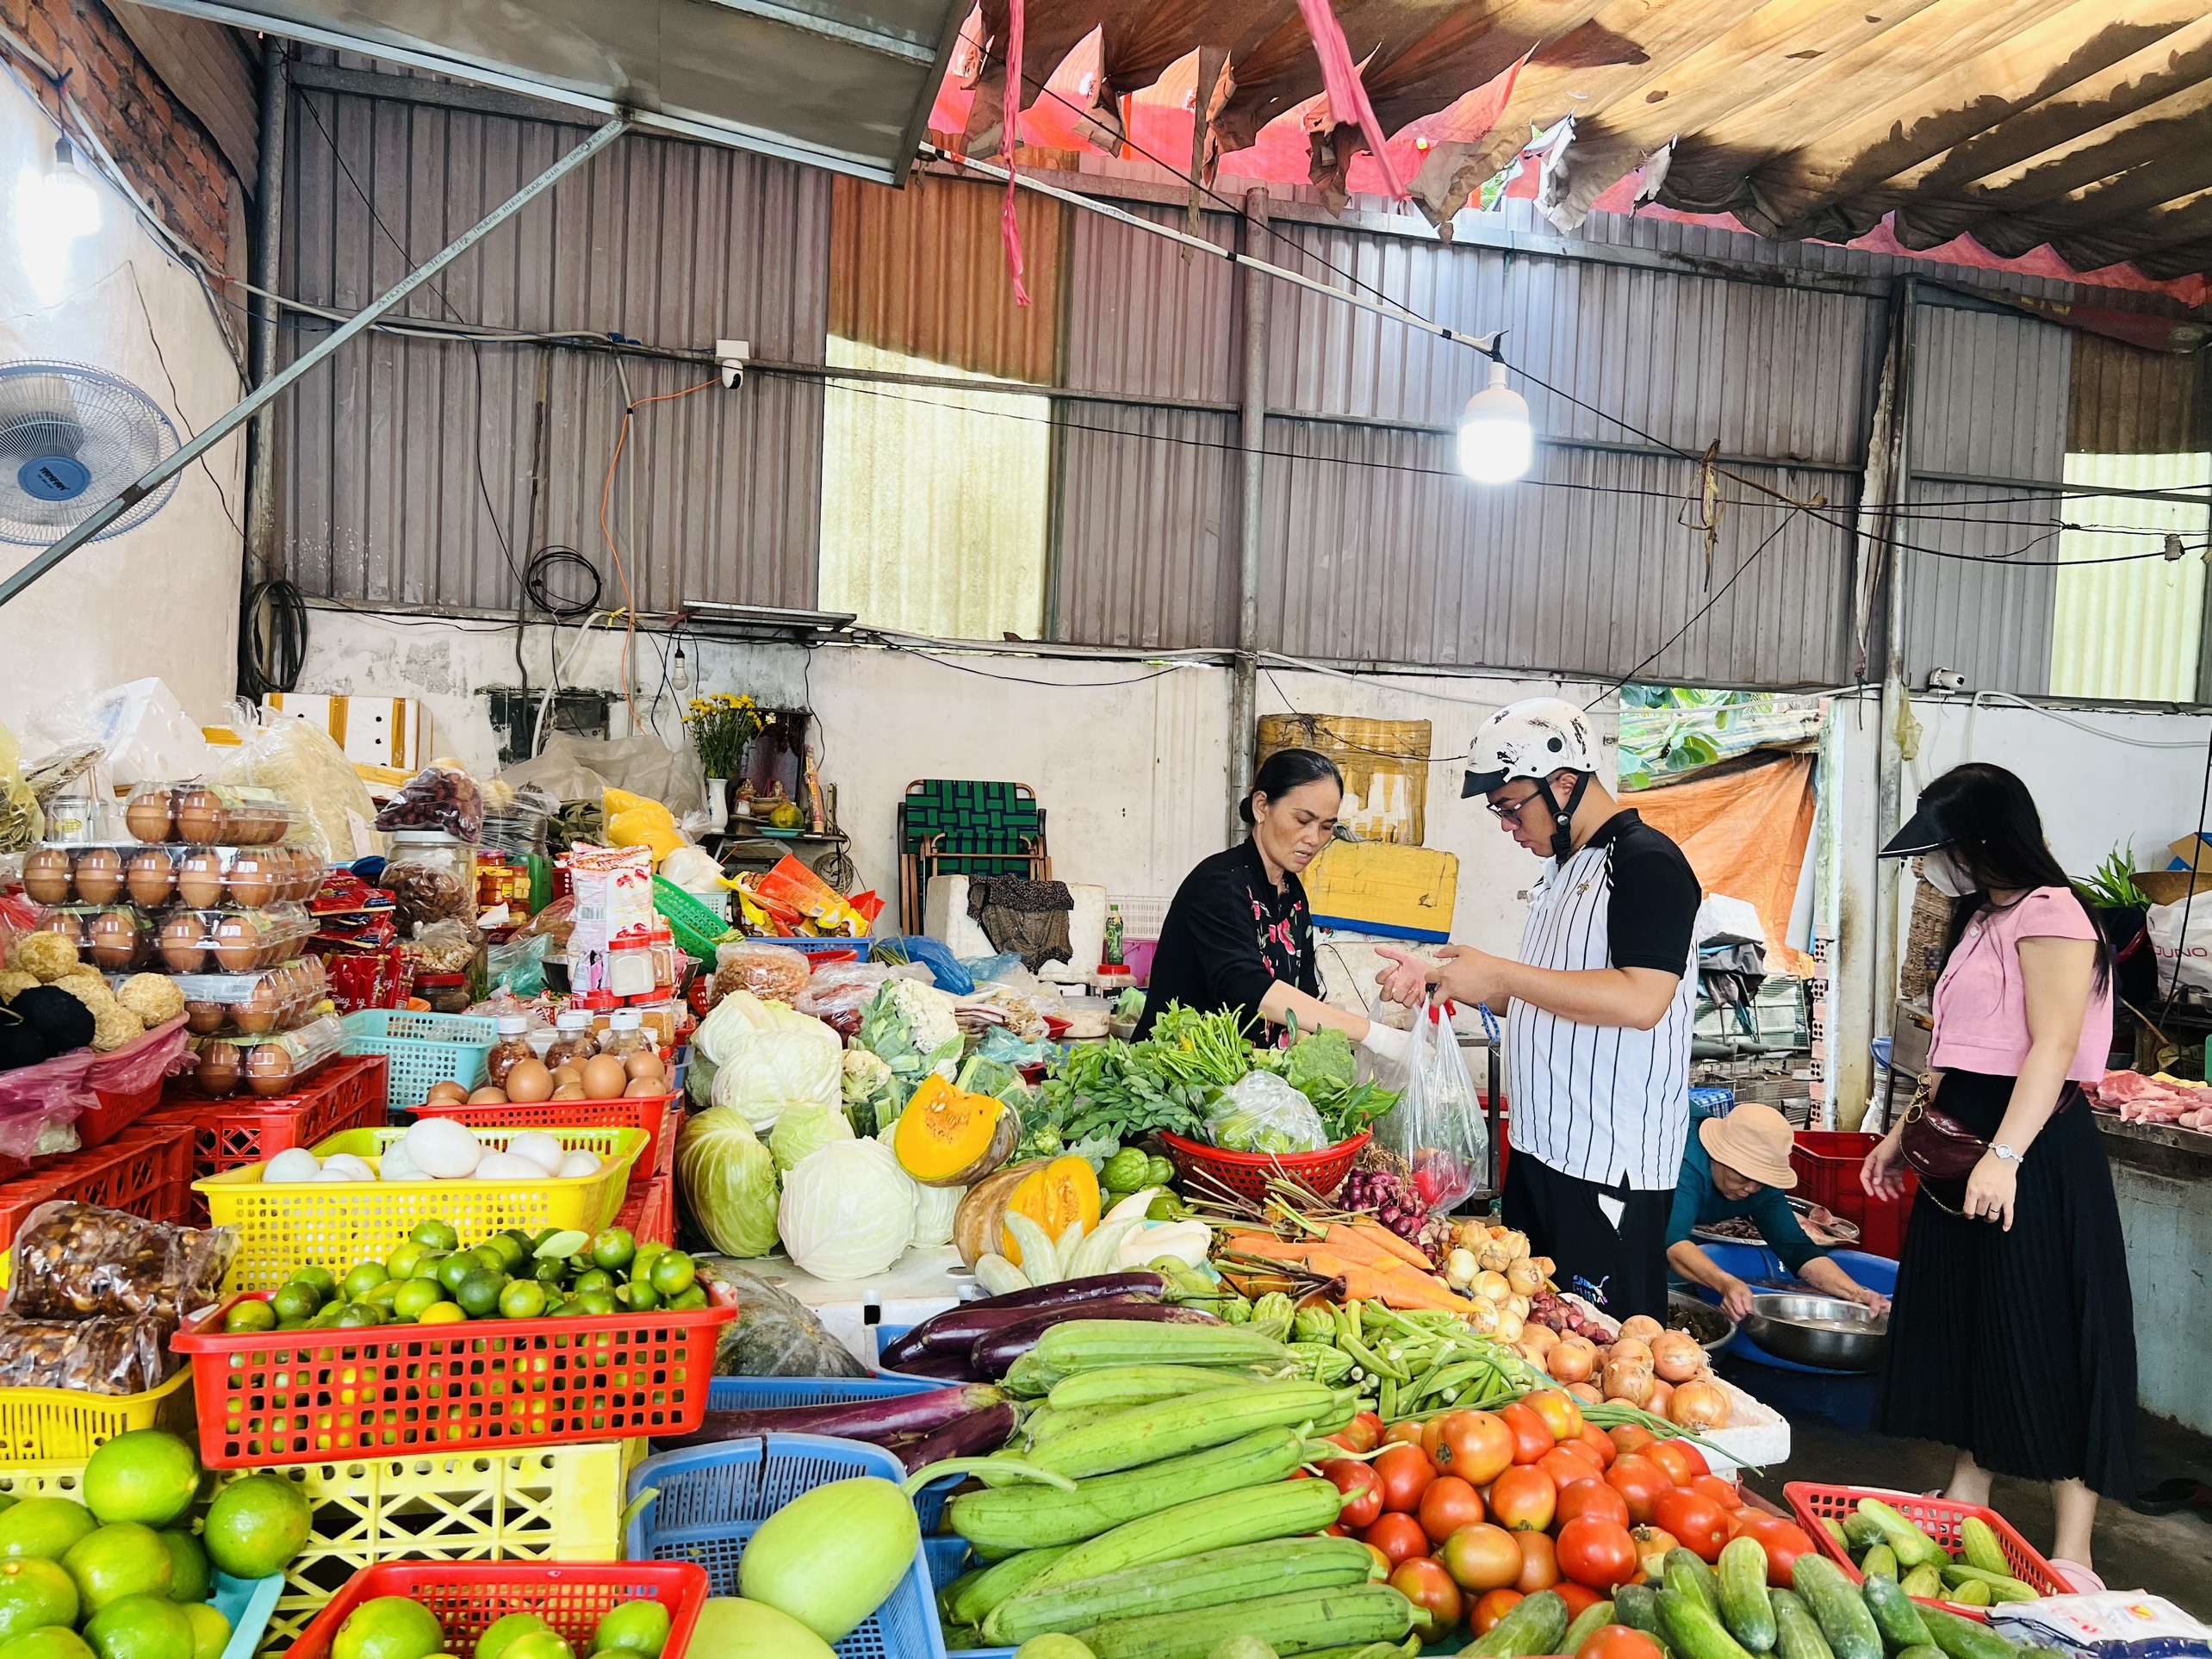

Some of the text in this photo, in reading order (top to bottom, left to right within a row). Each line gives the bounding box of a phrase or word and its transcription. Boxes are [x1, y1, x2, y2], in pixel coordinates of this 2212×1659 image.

[424, 250, 449, 270] STEEL
[501, 195, 522, 212] HIEU
[523, 179, 543, 196] QUOC
[544, 166, 560, 180] GIA
[1573, 1282, 1605, 1306] PUMA
